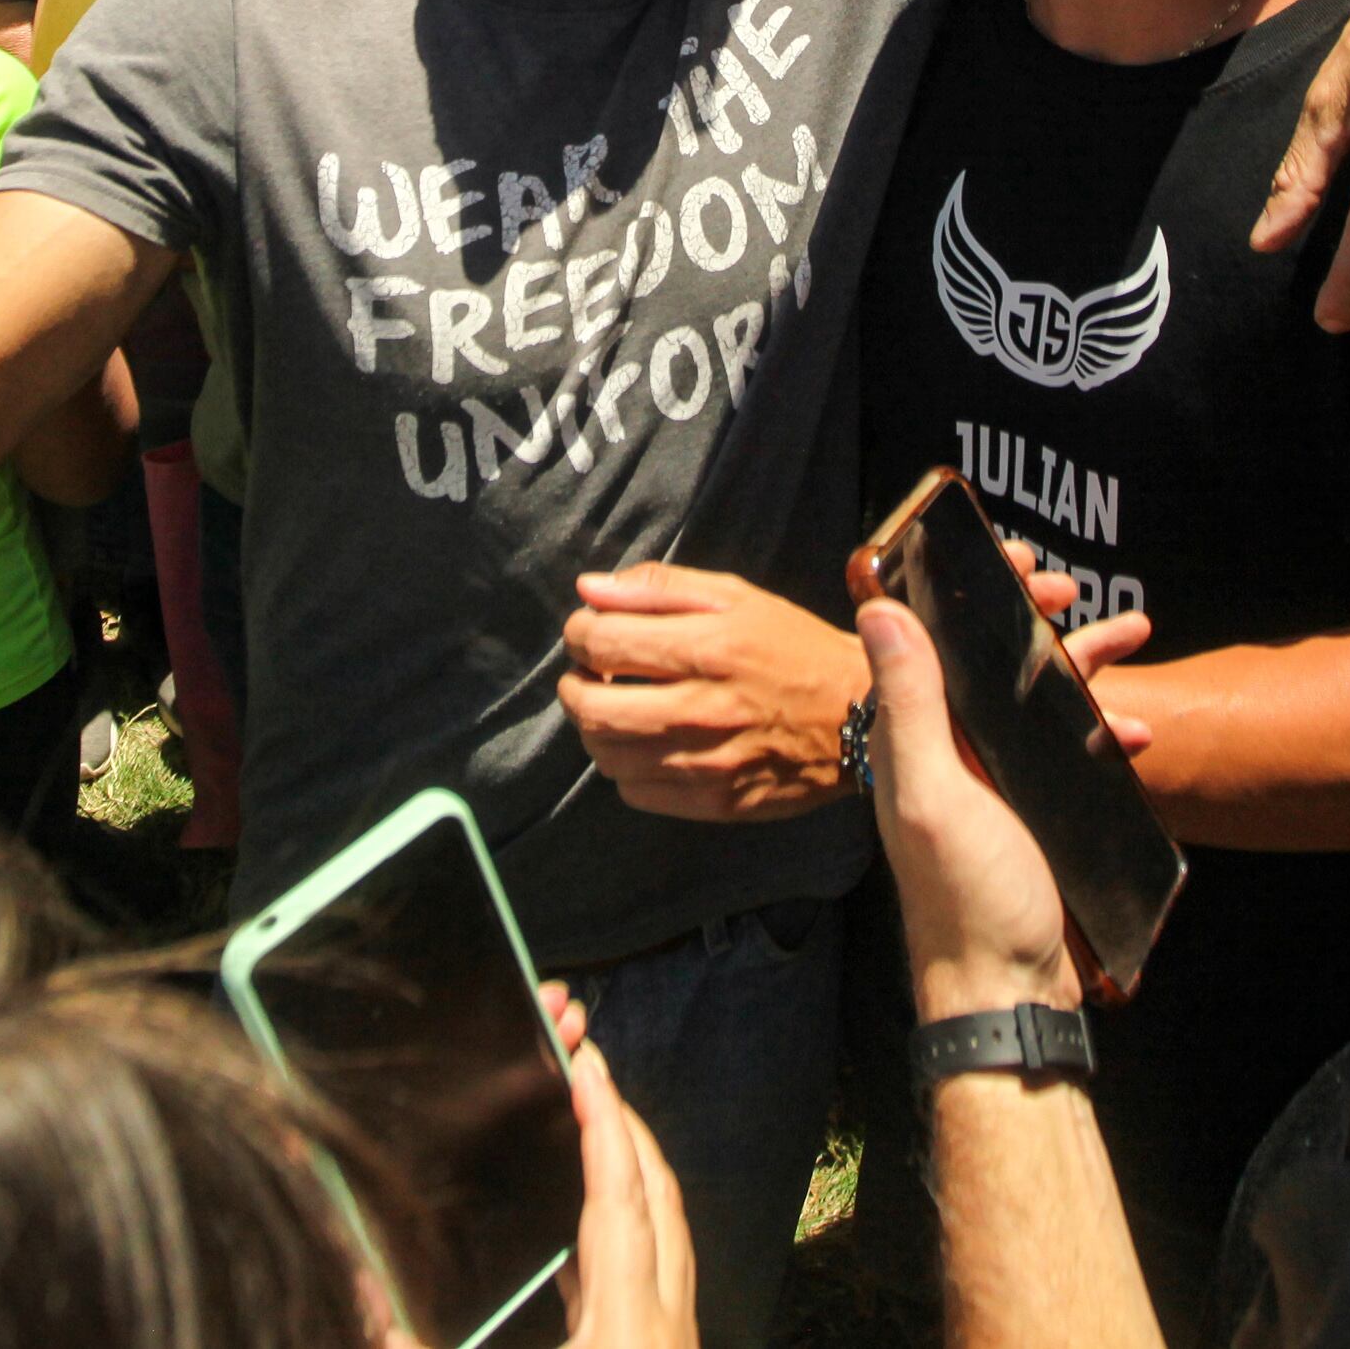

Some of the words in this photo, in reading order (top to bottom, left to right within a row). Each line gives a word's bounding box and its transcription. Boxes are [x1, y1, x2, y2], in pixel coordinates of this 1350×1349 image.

[318, 134, 623, 259] WEAR
[345, 124, 827, 385] FREEDOM
[395, 252, 812, 503] UNIFOR
[956, 420, 1119, 547] JULIAN
